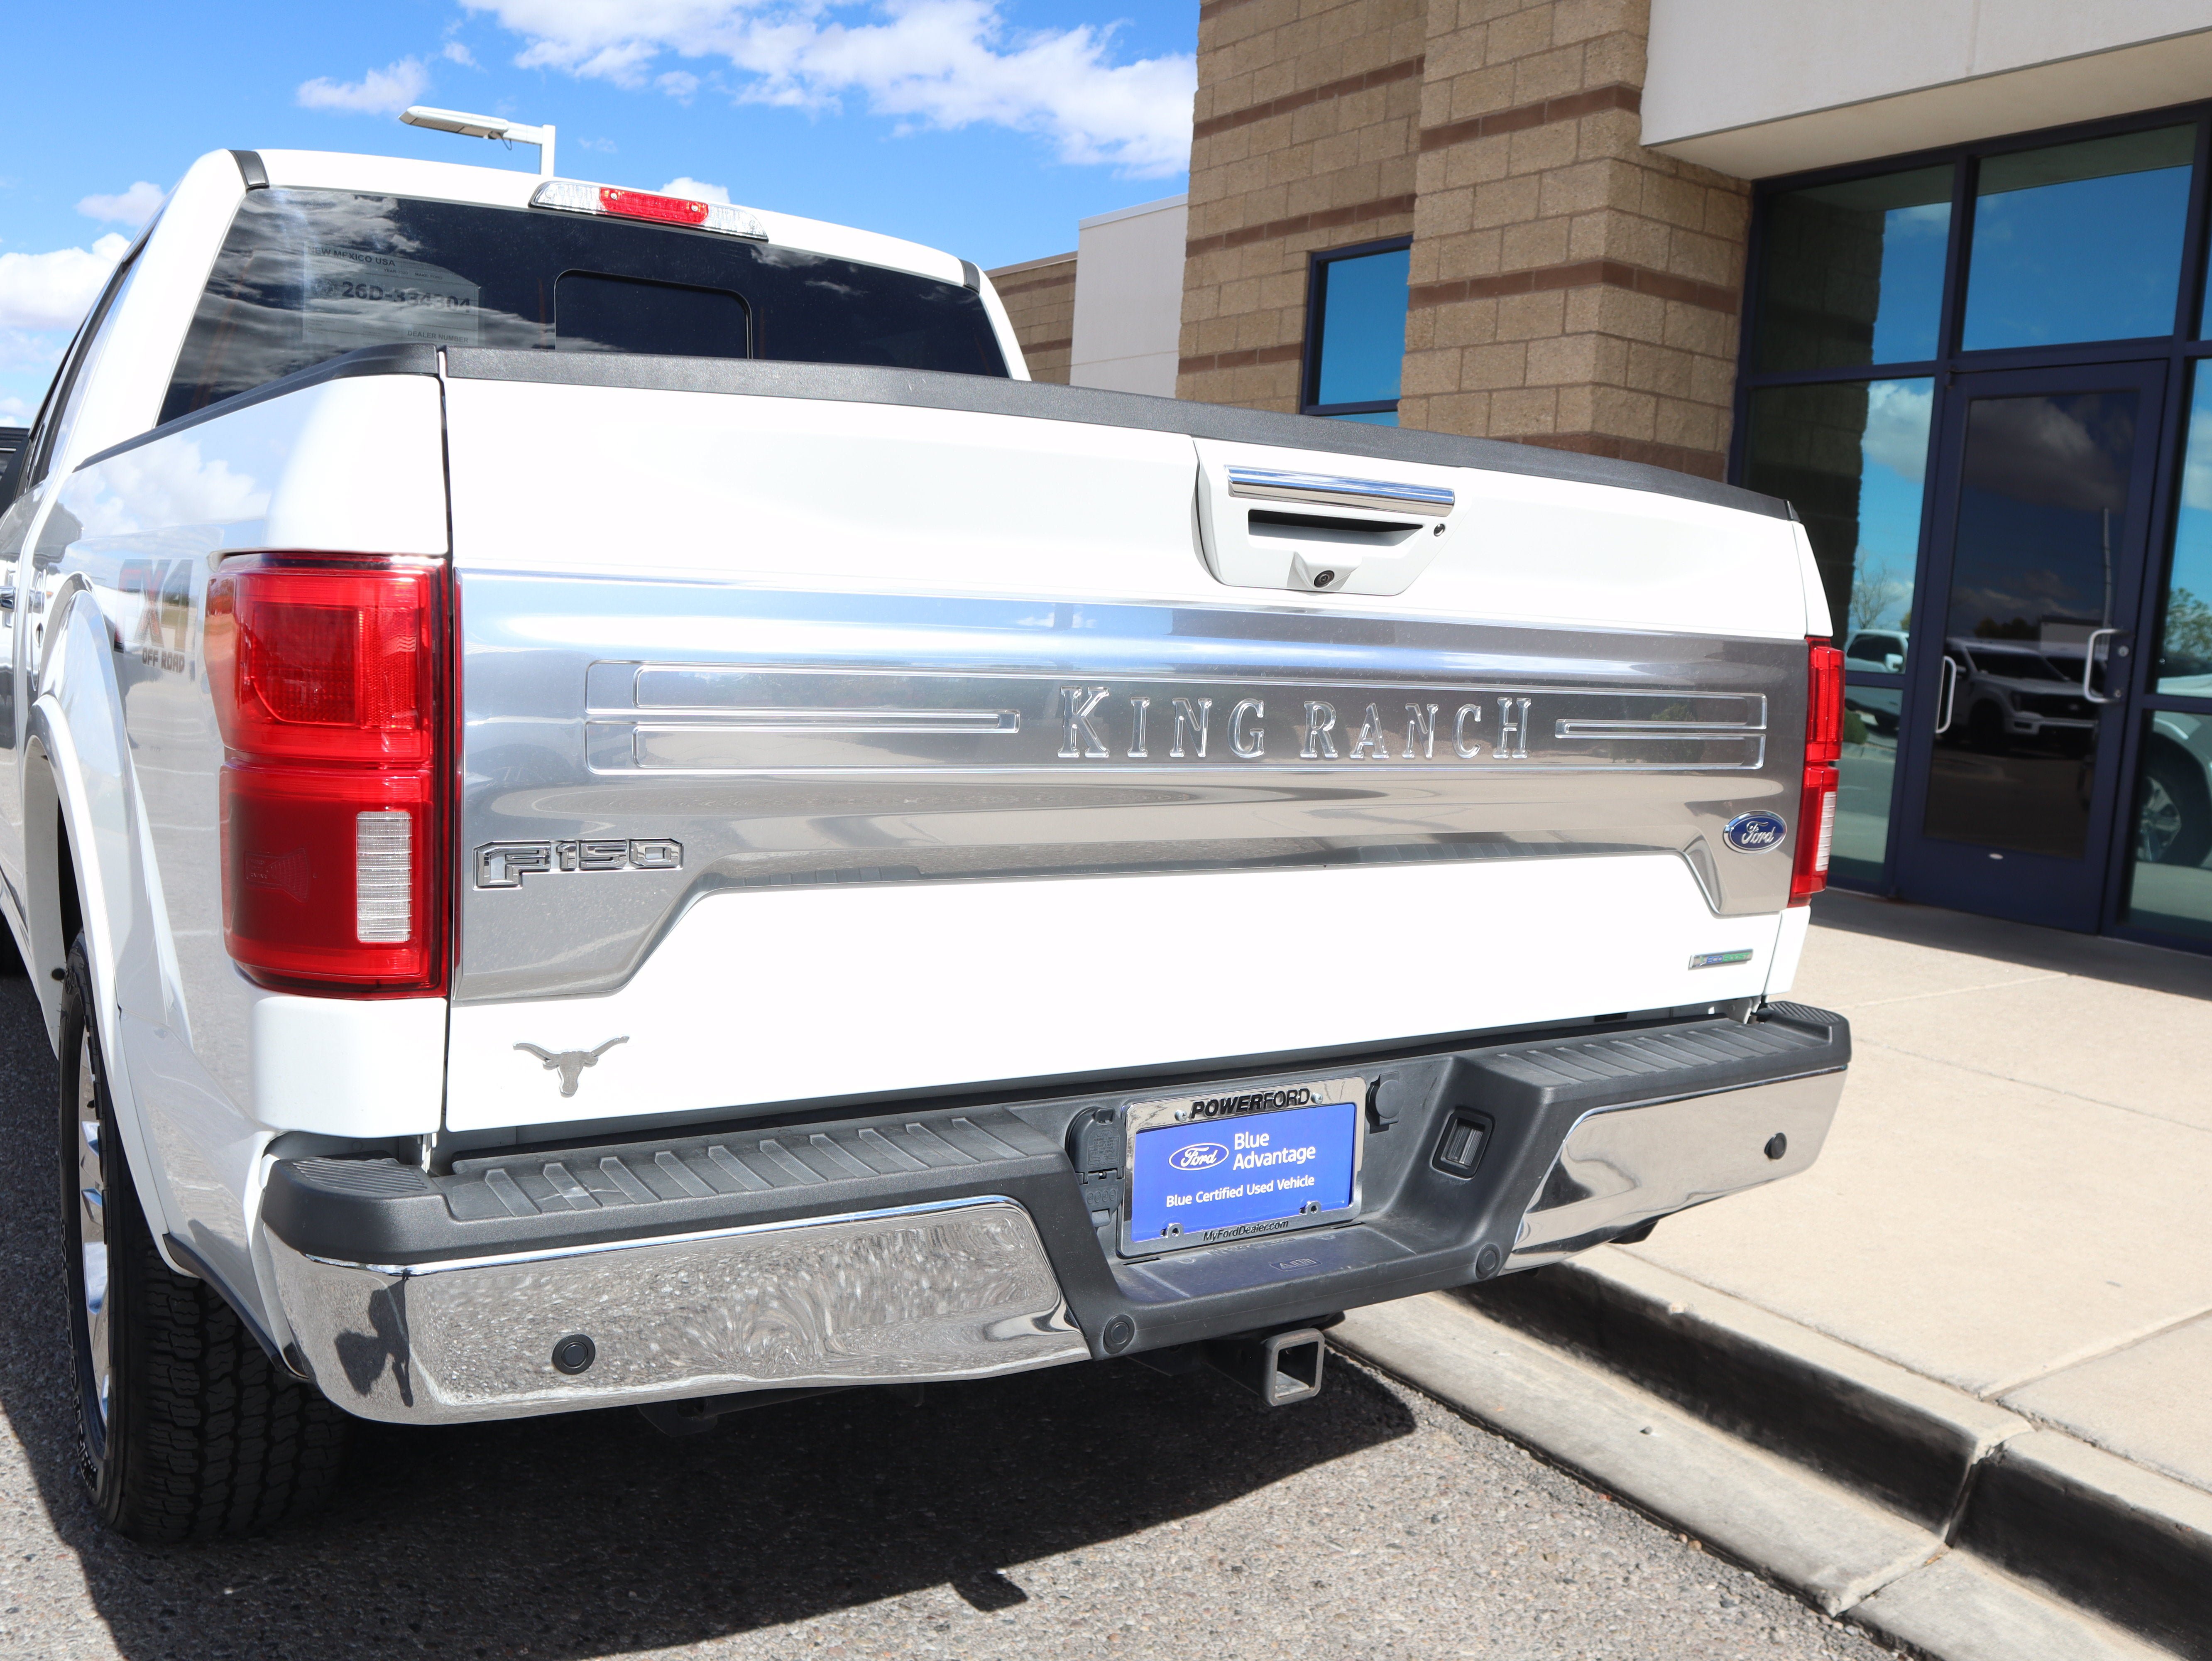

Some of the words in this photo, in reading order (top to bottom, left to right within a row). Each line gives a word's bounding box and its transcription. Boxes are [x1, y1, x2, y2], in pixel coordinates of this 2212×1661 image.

[308, 245, 331, 256] NEW
[333, 250, 372, 263] MEXICO
[375, 257, 396, 267] USA
[342, 281, 470, 313] 26D-334304
[407, 330, 436, 339] DEALER
[438, 334, 468, 343] NUMBER
[113, 559, 193, 654] FX4
[142, 647, 158, 666] OFF
[161, 650, 185, 674] ROAD
[1057, 686, 1265, 759] KING
[1299, 697, 1532, 759] RANCH
[1741, 821, 1775, 844] Ford
[1234, 1132, 1270, 1151] Blue
[1179, 1145, 1218, 1168] Ford
[1232, 1145, 1316, 1171] Advantage
[1166, 1194, 1192, 1208] Blue
[1195, 1185, 1243, 1204] Certified
[1246, 1179, 1274, 1196] Used
[1277, 1175, 1315, 1191] Vehicle
[1203, 1220, 1289, 1242] MyFordDealer.com
